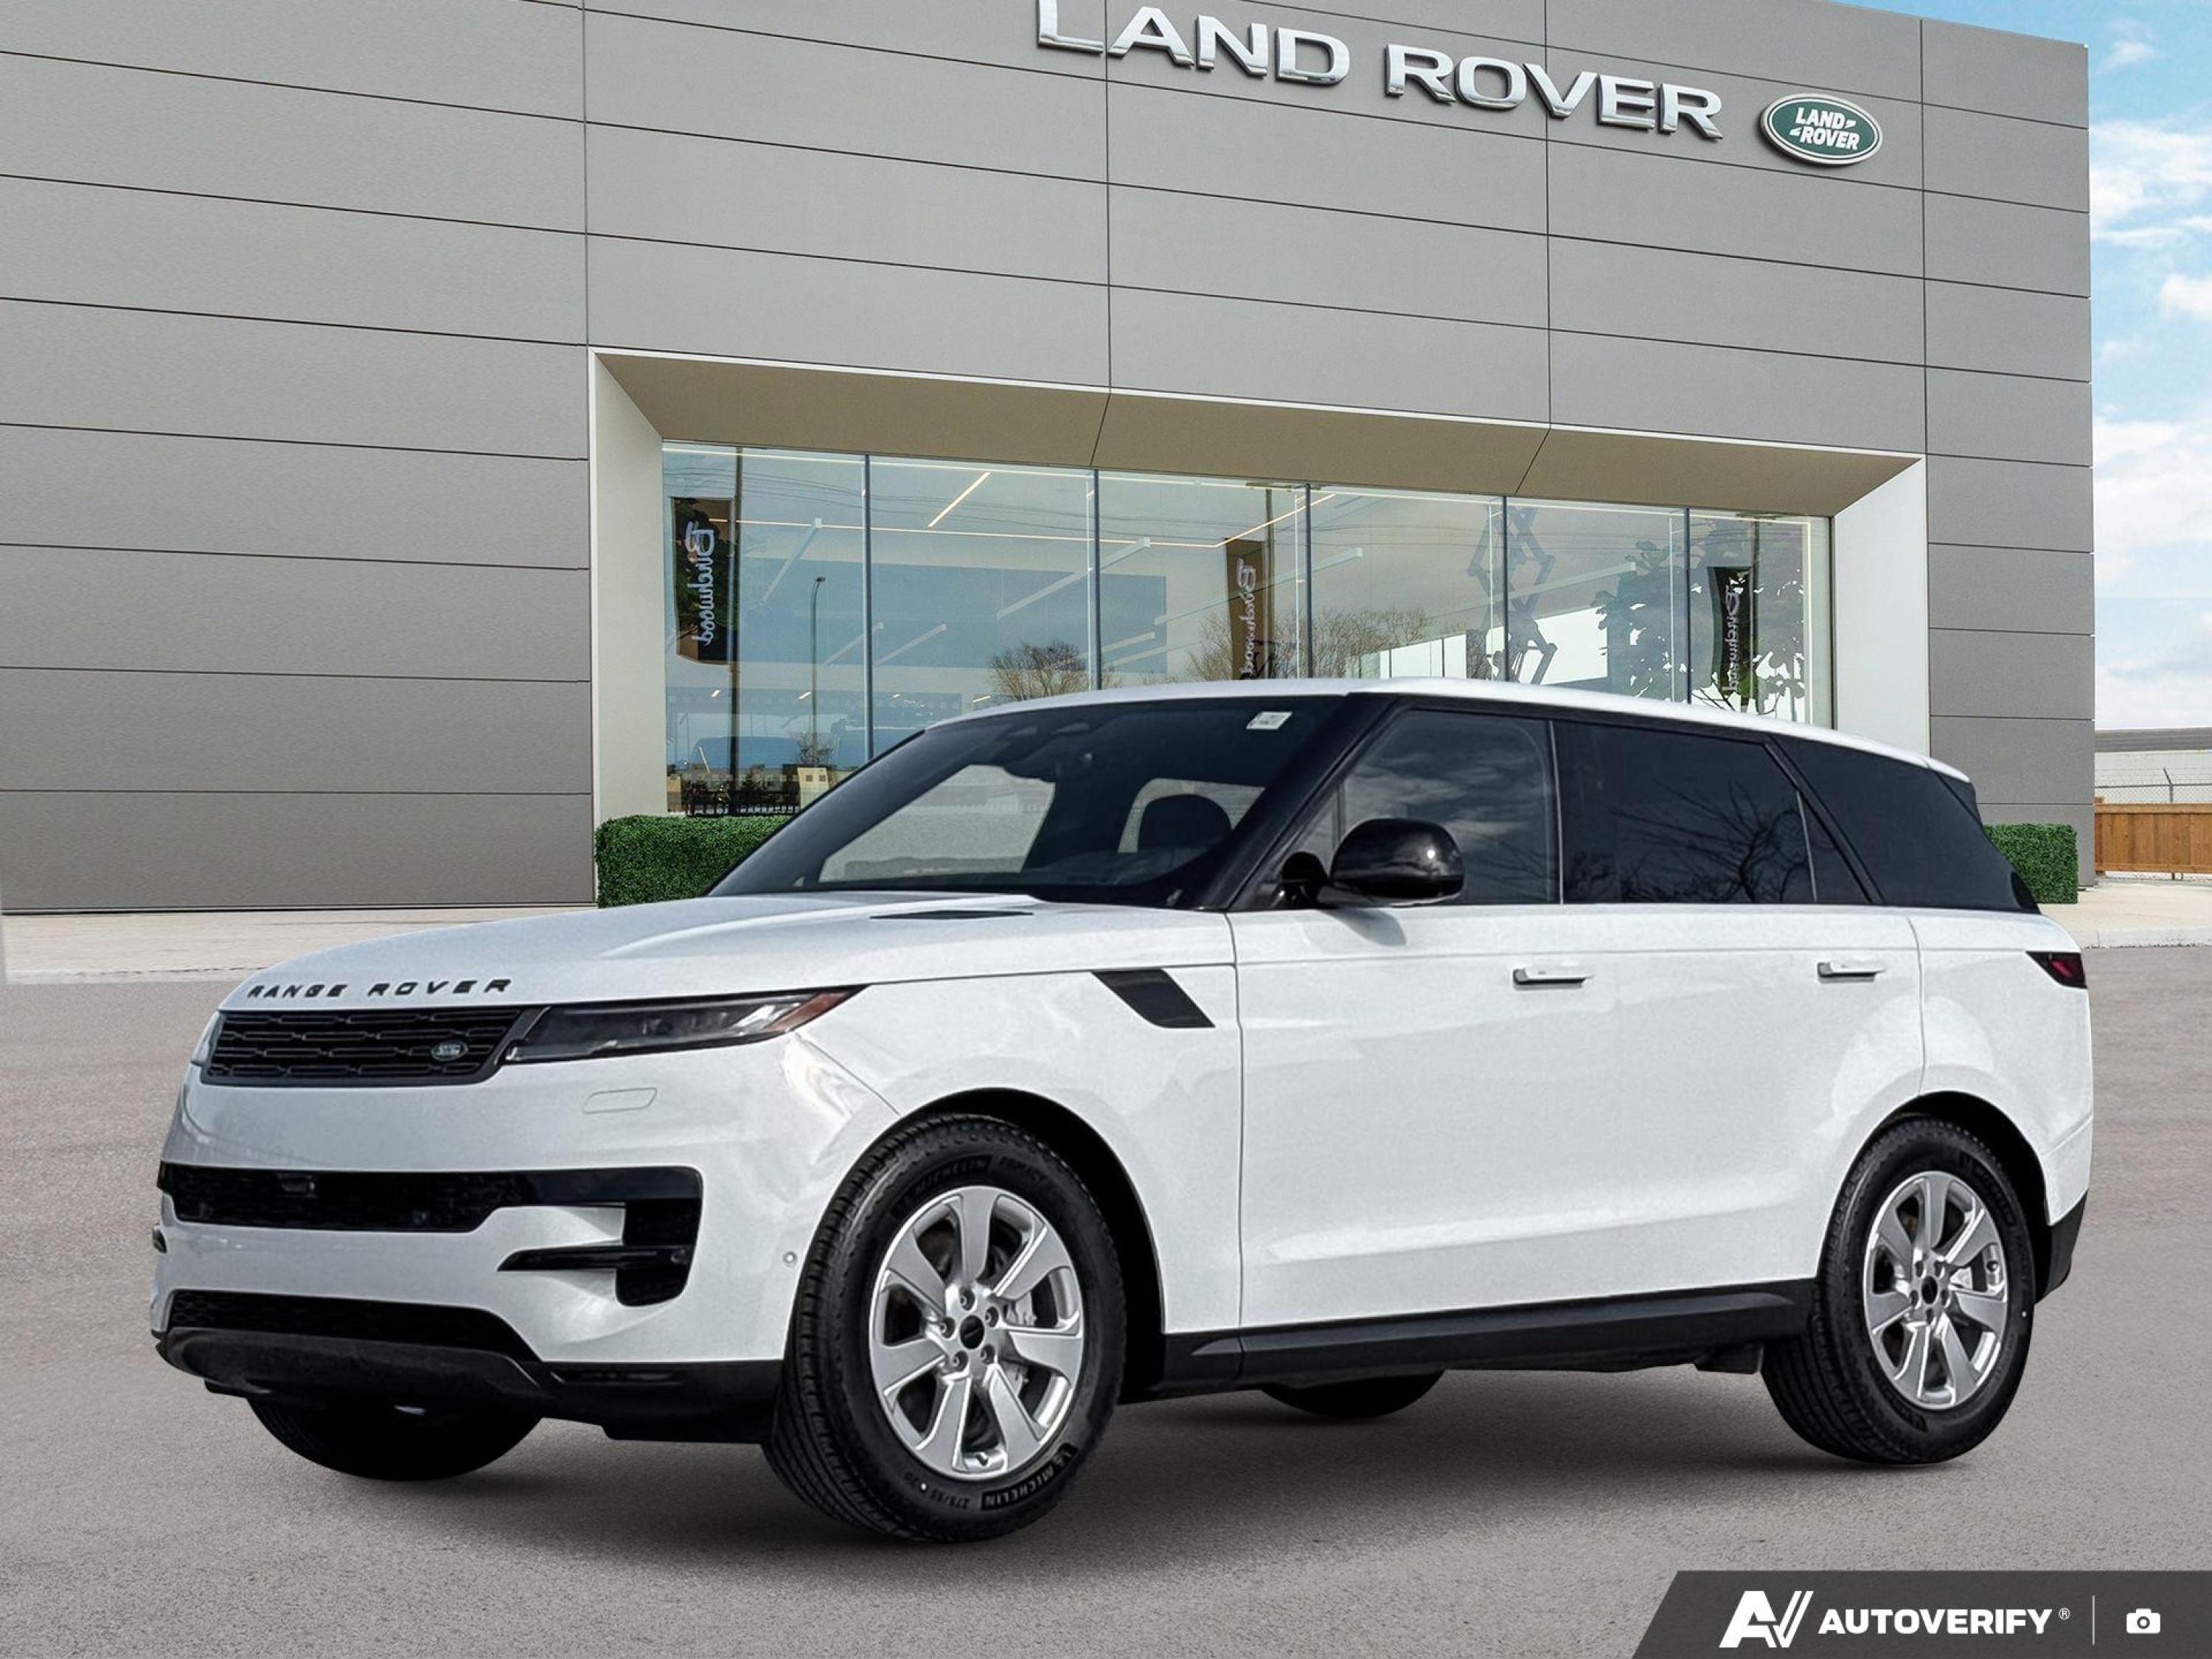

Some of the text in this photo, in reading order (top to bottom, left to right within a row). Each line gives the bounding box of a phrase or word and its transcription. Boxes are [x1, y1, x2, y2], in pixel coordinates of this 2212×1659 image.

[1037, 0, 1724, 139] LAND ROVER
[1795, 107, 1846, 129] LAND
[1800, 127, 1860, 150] ROVER
[247, 978, 512, 998] RANGE ROVER
[984, 1464, 1057, 1509] MICHELIN
